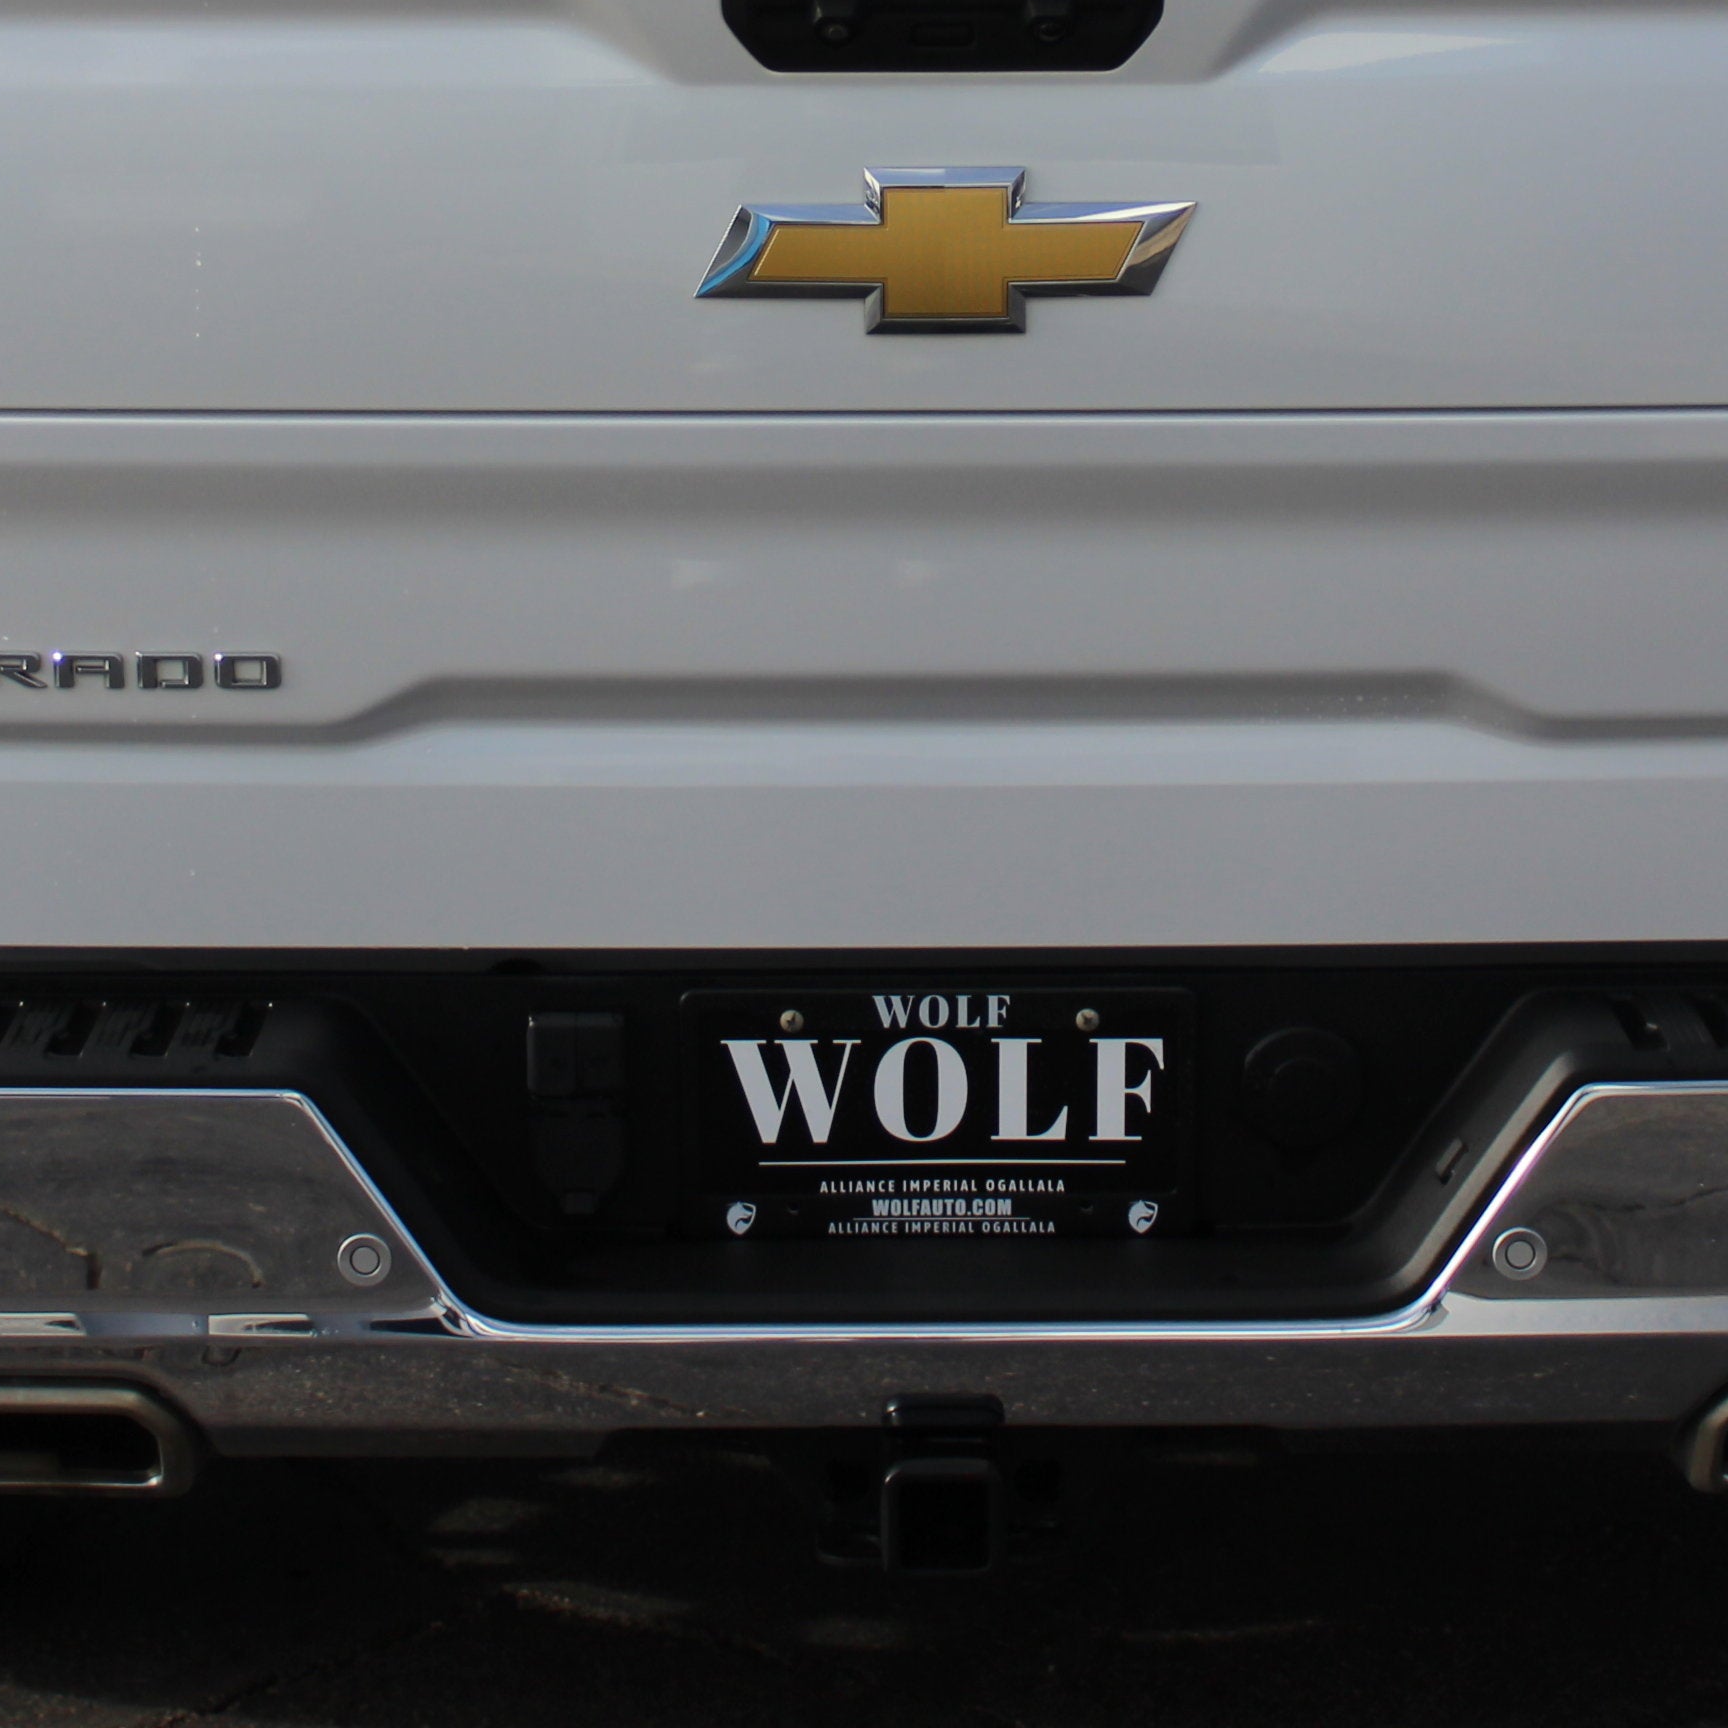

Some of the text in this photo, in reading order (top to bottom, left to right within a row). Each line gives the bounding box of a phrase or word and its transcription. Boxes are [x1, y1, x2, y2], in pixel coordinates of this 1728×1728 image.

[872, 994, 1011, 1029] WOLF
[720, 1037, 1165, 1143] WOLF
[819, 1178, 1066, 1194] ALLIANCE IMPERIAL OGALLALA
[871, 1198, 1013, 1217] WOLFAUTO.COM
[828, 1221, 1056, 1235] ALLIANCE IMPERIAL OGALLALA
